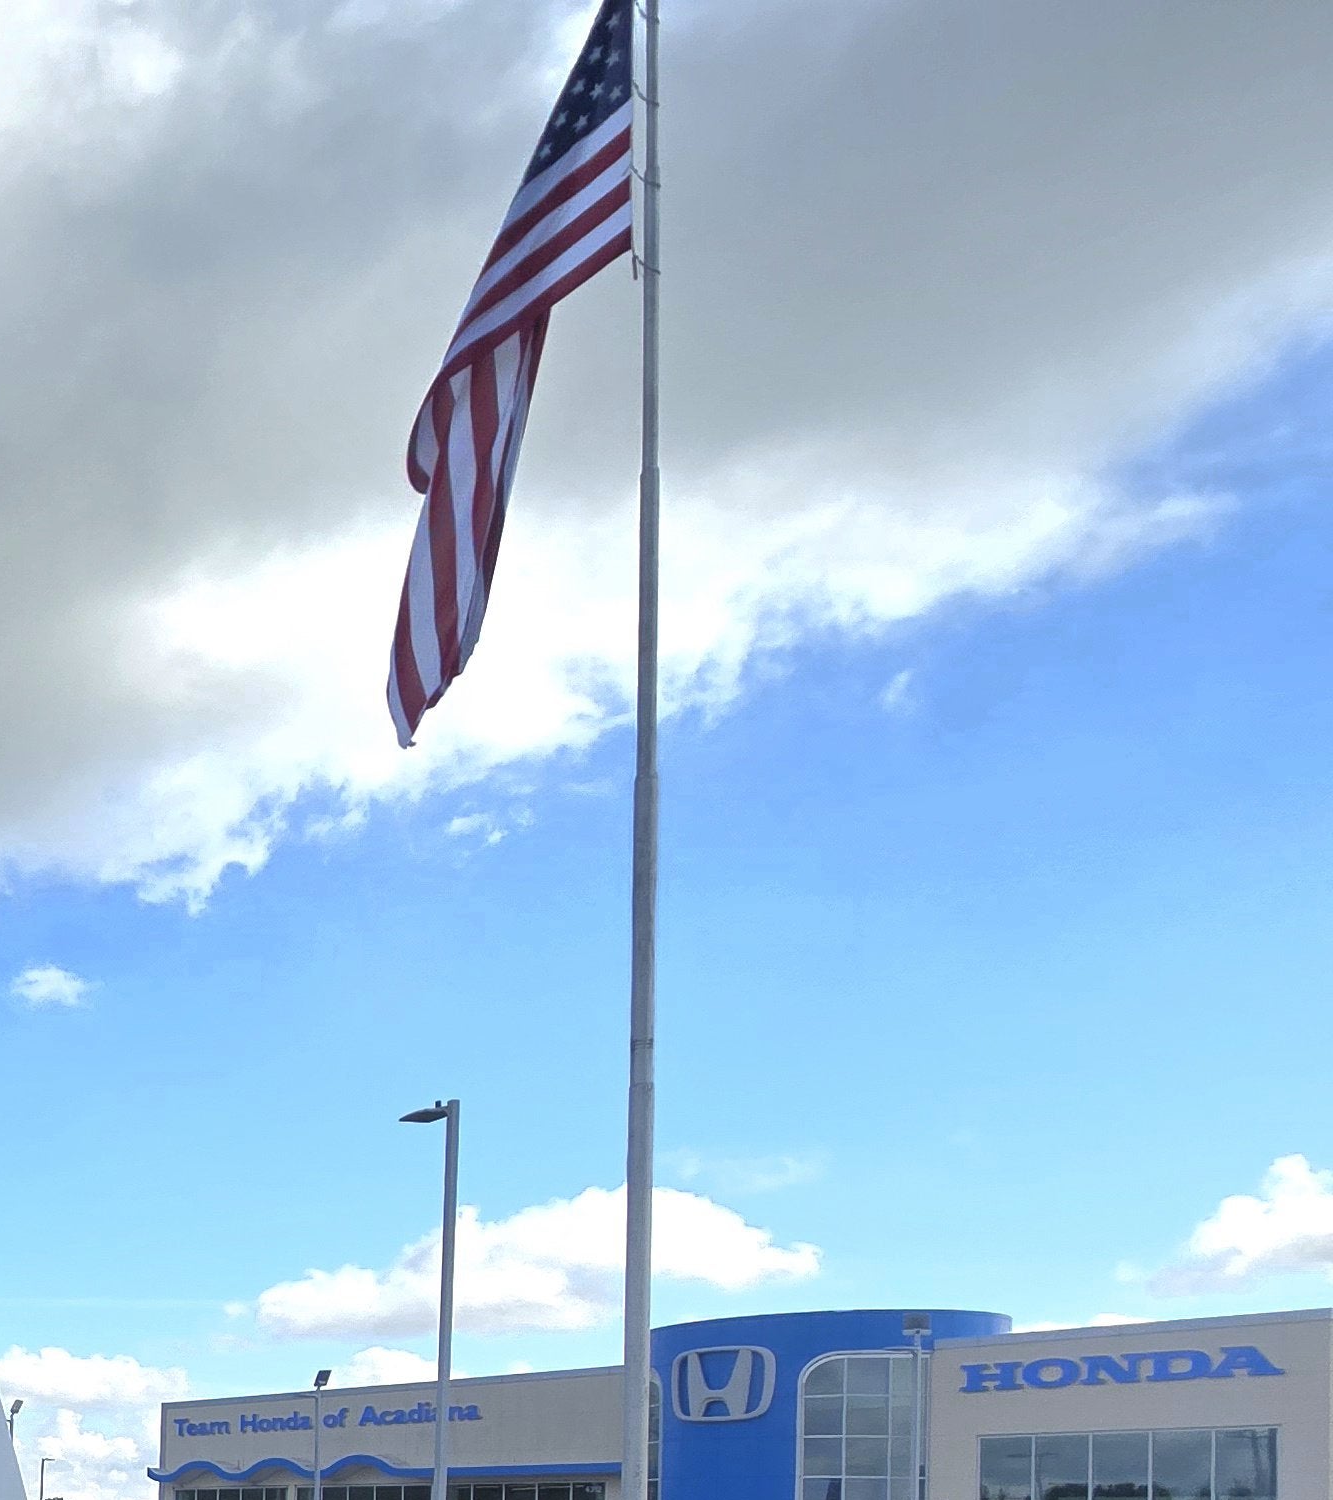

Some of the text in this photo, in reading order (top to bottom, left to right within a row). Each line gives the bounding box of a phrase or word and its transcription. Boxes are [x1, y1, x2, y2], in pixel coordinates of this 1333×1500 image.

[958, 1345, 1286, 1393] HONDA
[173, 1418, 231, 1437] Team
[240, 1410, 314, 1434] Honda
[323, 1407, 350, 1428] of
